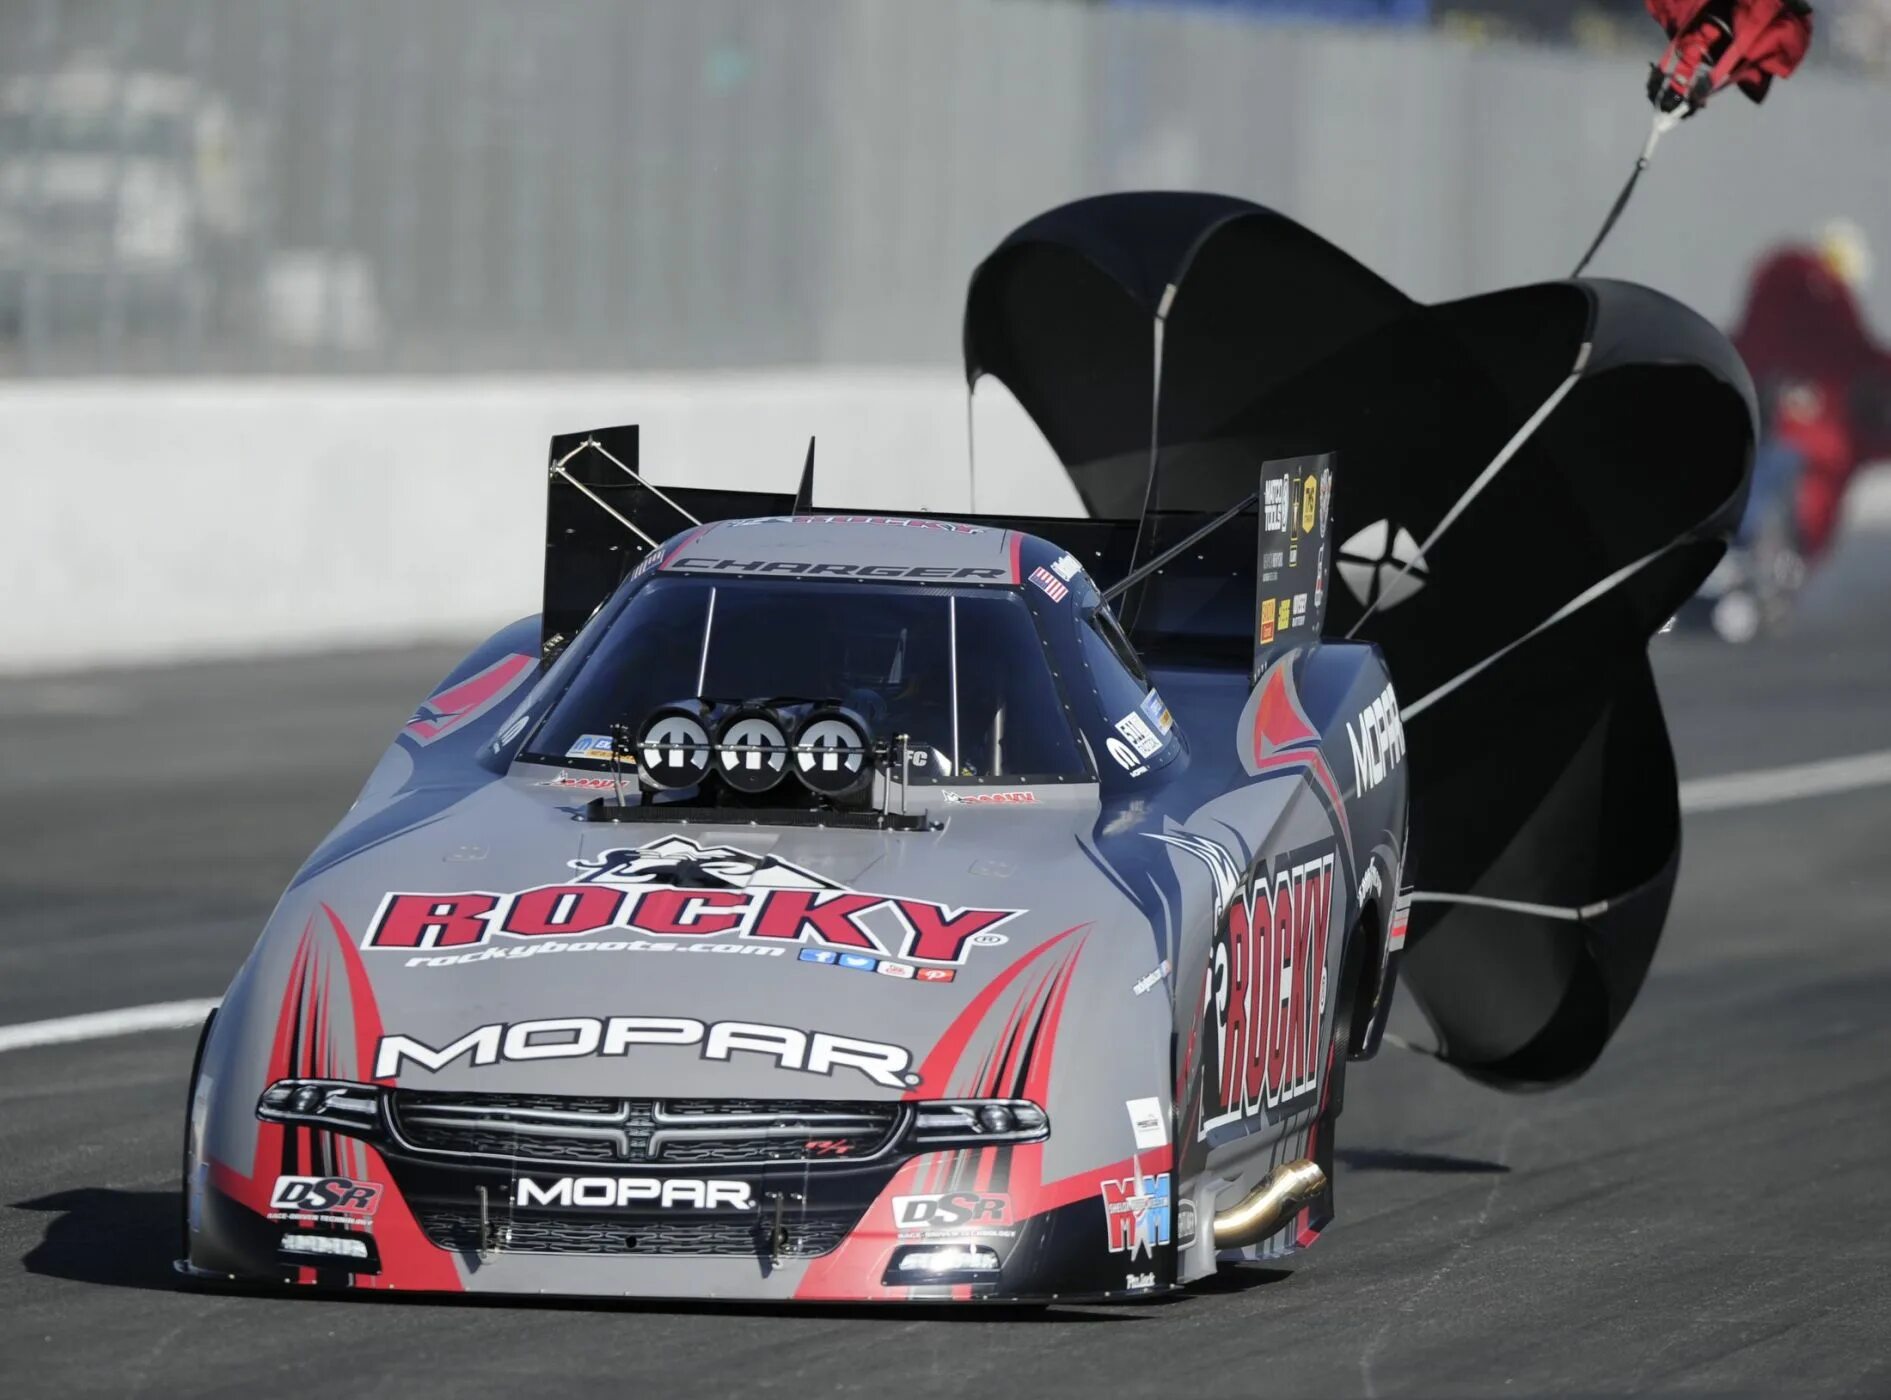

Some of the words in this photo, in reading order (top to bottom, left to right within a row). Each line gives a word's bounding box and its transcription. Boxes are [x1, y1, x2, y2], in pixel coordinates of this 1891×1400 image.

[671, 556, 1007, 580] CHARGER
[1345, 682, 1406, 799] MOPAR
[361, 884, 1029, 965] ROCKY
[404, 941, 786, 968] rockyboots.com
[1218, 852, 1336, 1122] ROCKY
[373, 1016, 919, 1088] MOPAR
[277, 1178, 377, 1211] DSR
[516, 1177, 753, 1210] MOPAR
[901, 1191, 1006, 1227] DSR
